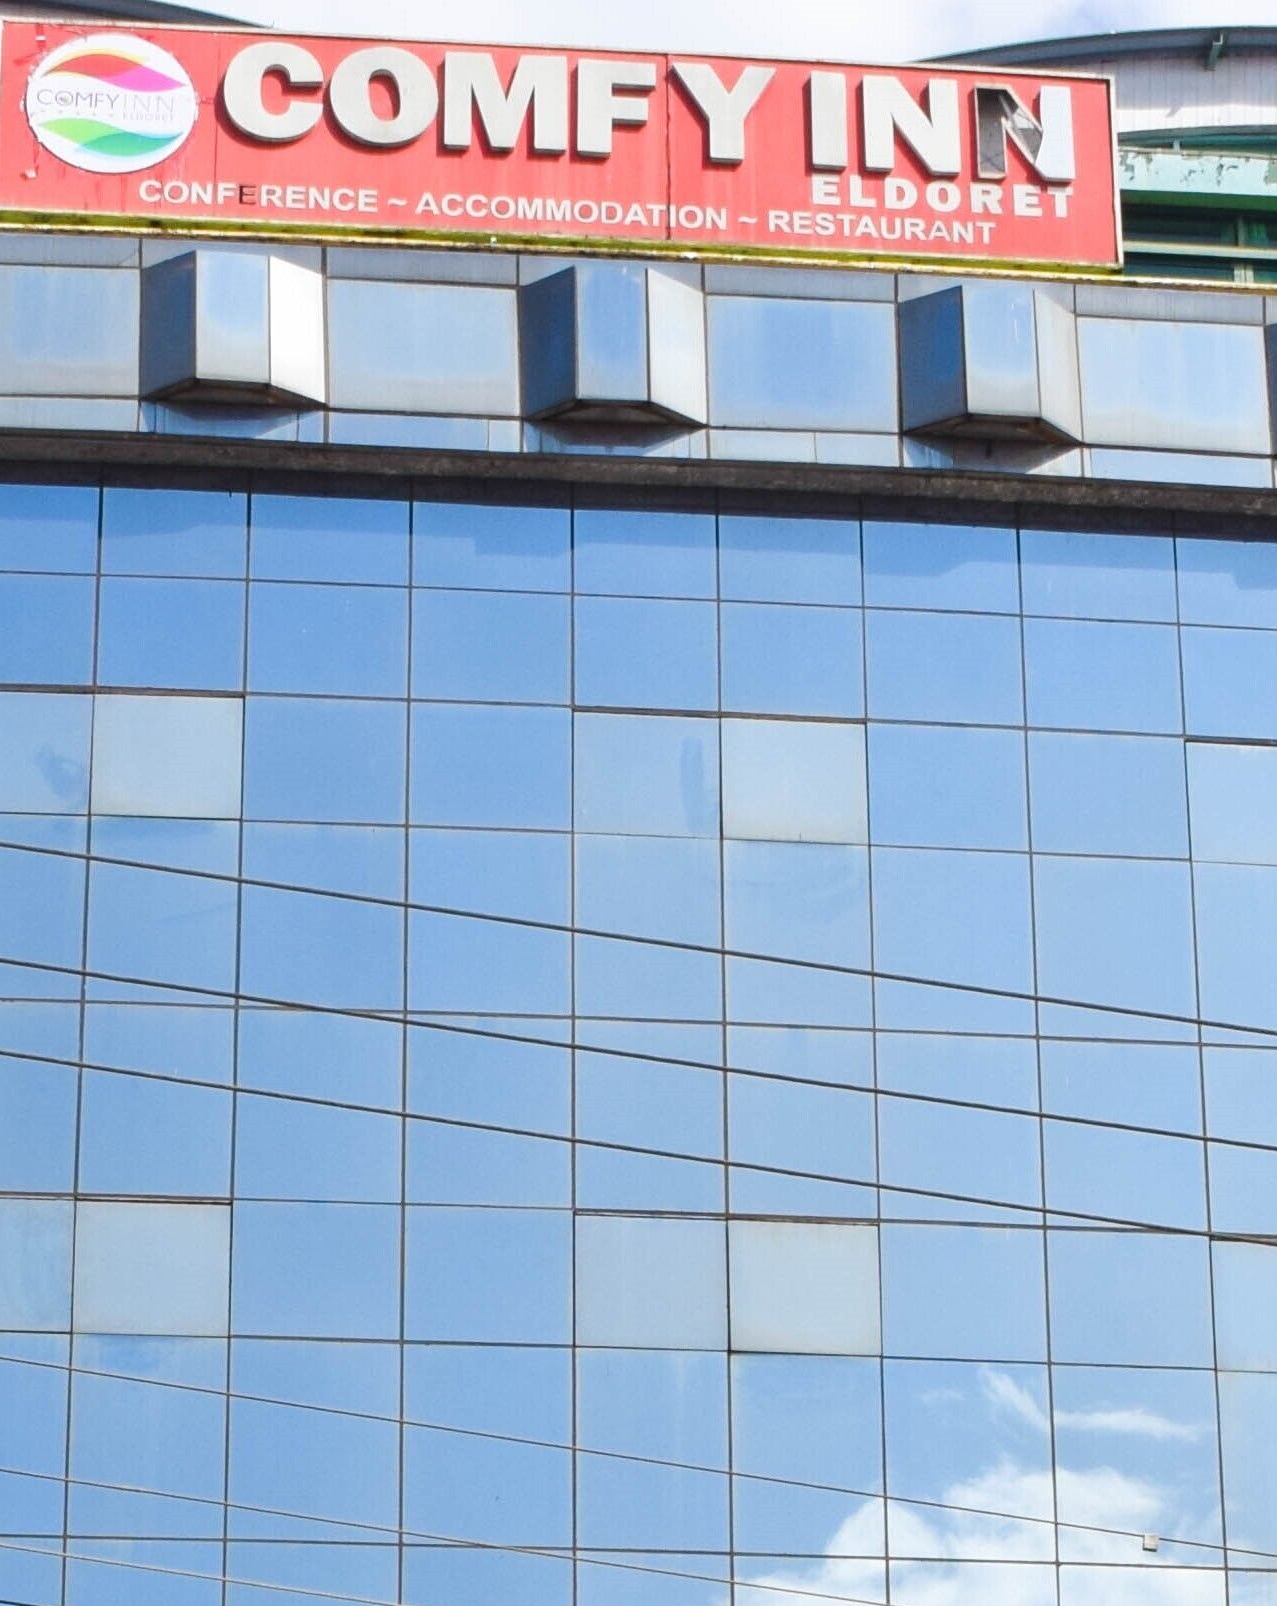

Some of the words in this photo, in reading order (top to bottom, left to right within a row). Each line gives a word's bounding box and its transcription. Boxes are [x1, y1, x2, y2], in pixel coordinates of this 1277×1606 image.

[221, 41, 776, 164] COMFY
[807, 70, 1076, 183] INN
[138, 180, 379, 213] CONFERENCE
[415, 192, 727, 230] ACCOMMODATION
[768, 210, 996, 244] RESTAURANT
[811, 174, 1074, 218] ELDORET
